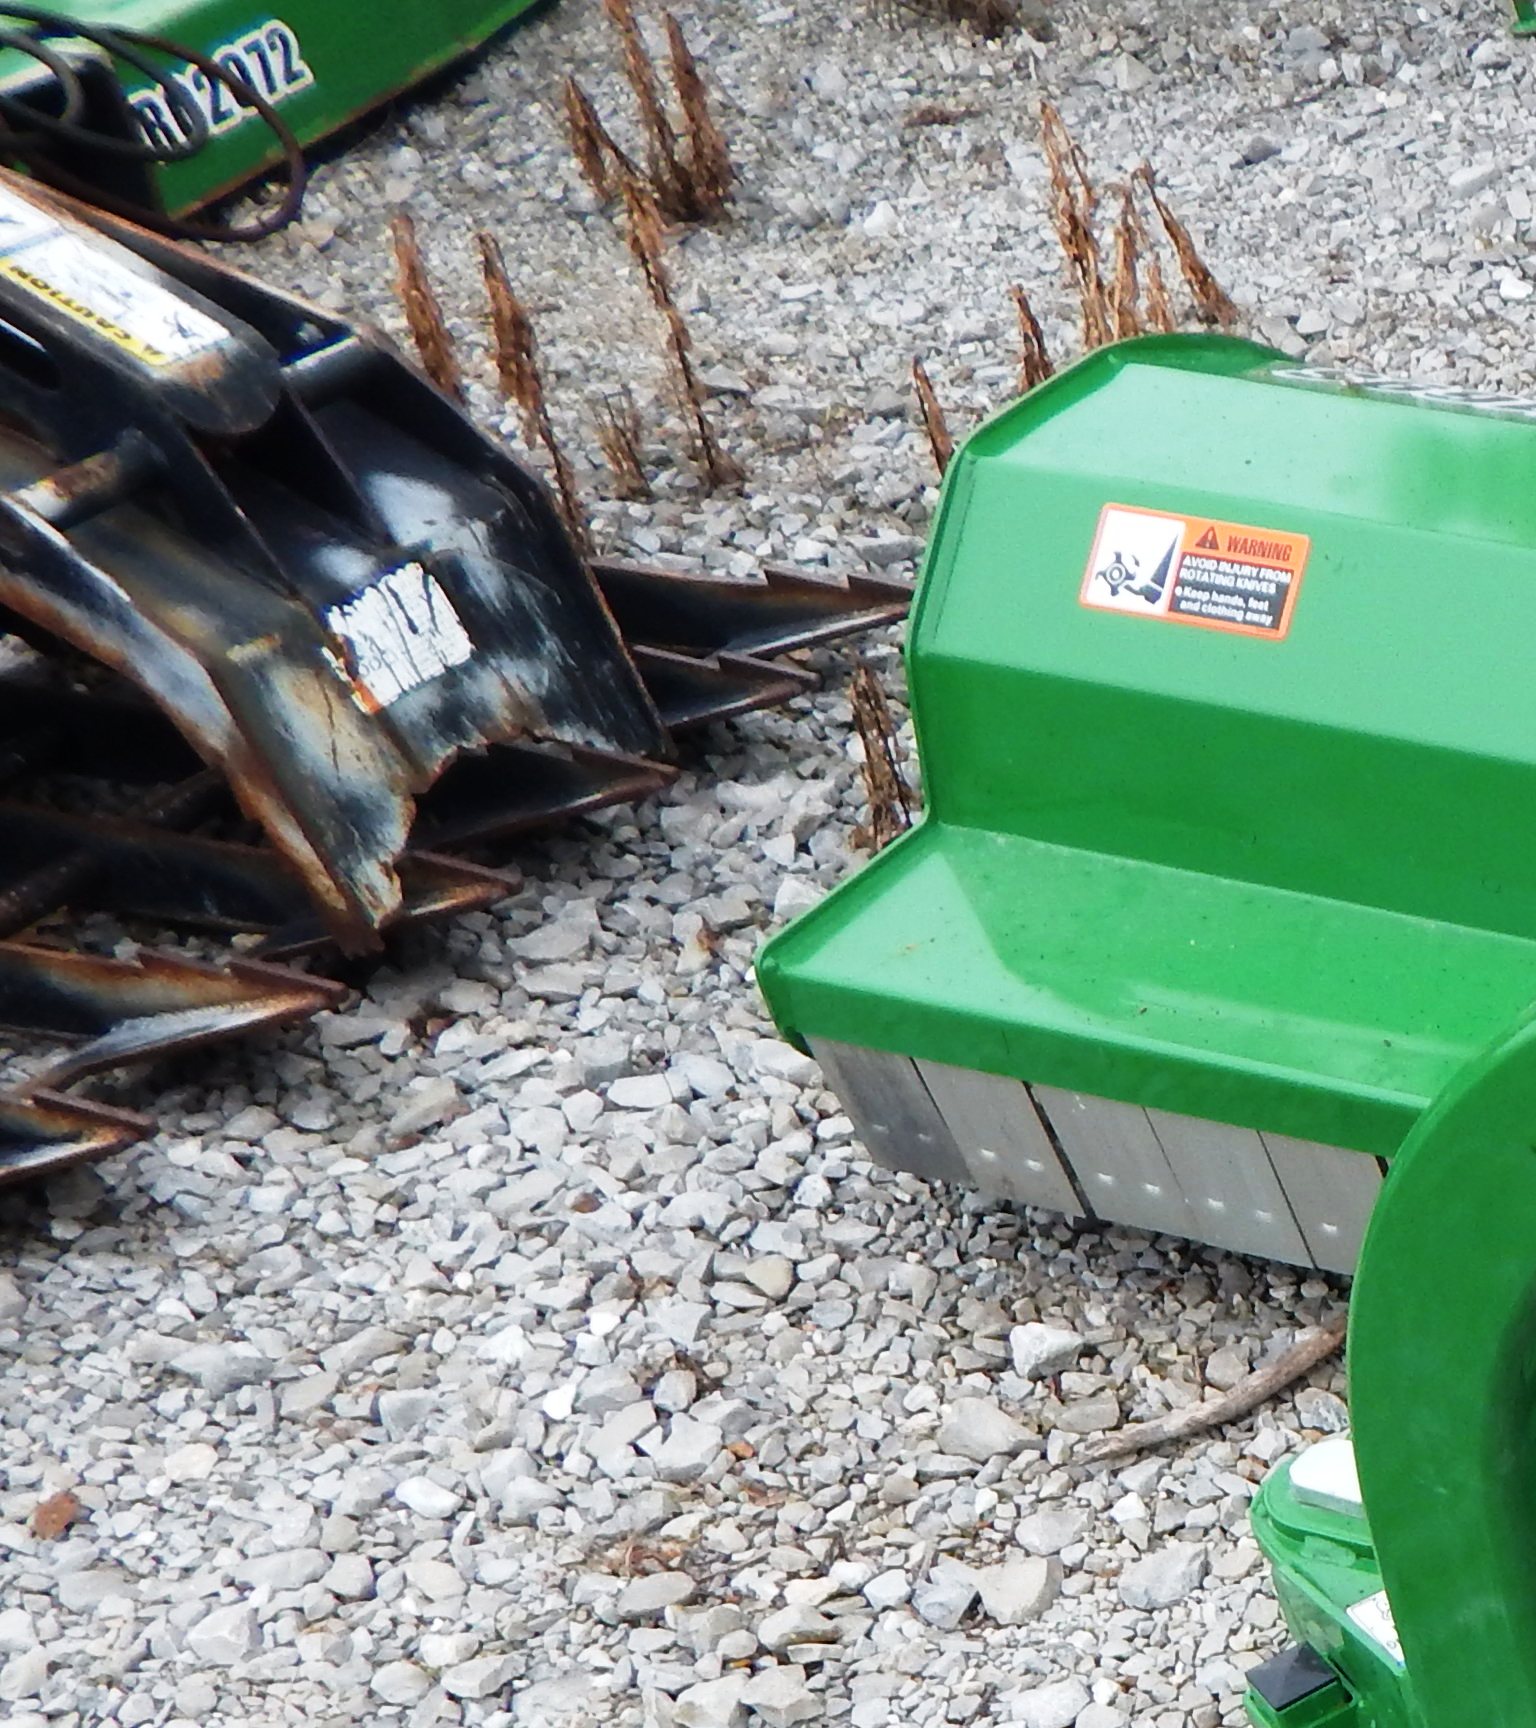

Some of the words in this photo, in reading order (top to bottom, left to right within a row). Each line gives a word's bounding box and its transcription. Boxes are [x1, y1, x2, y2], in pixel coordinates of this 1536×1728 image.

[1227, 536, 1293, 561] WARNING
[1180, 567, 1235, 587] ROTATING
[1237, 577, 1276, 594] KNIVES
[1184, 555, 1217, 569] AVOID
[1219, 561, 1258, 577] INJURY
[1260, 568, 1291, 582] FROM
